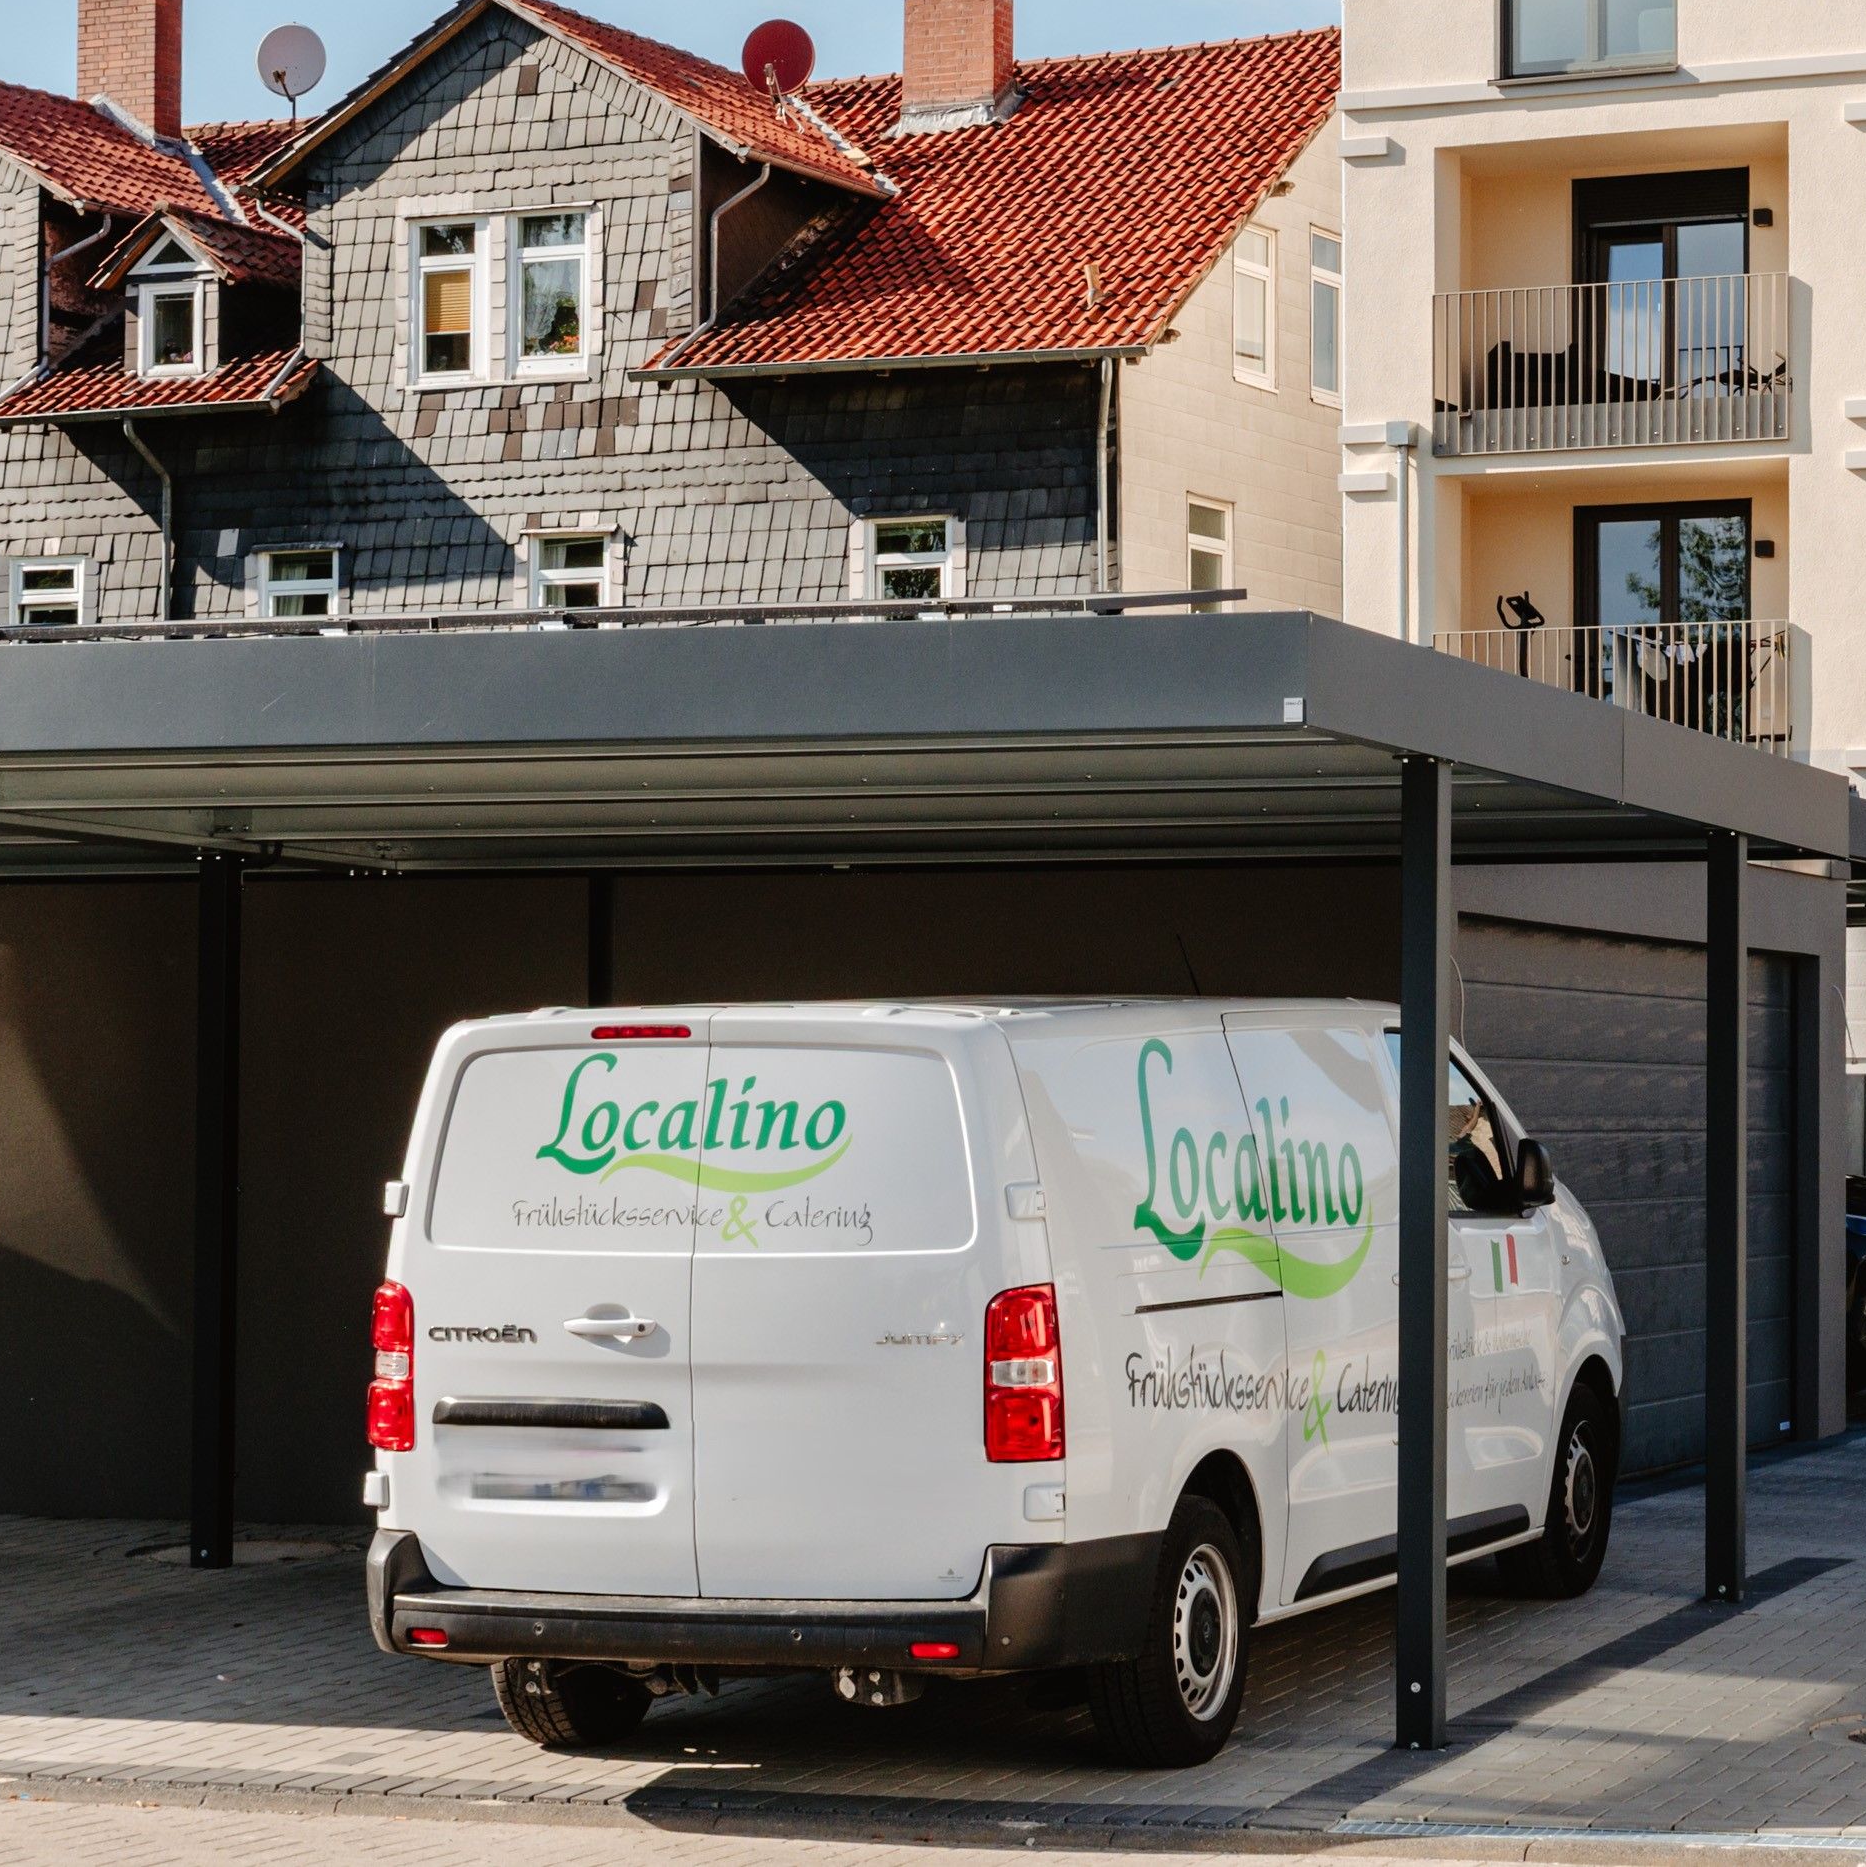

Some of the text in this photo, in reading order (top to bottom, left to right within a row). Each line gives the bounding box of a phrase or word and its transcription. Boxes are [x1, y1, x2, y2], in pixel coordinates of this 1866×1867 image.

[536, 1053, 846, 1175] Localino
[1134, 1038, 1363, 1261] Localino
[512, 1195, 873, 1248] Frühstücksservice & Catering
[1125, 1343, 1399, 1455] Frühstücksservice & Caterin
